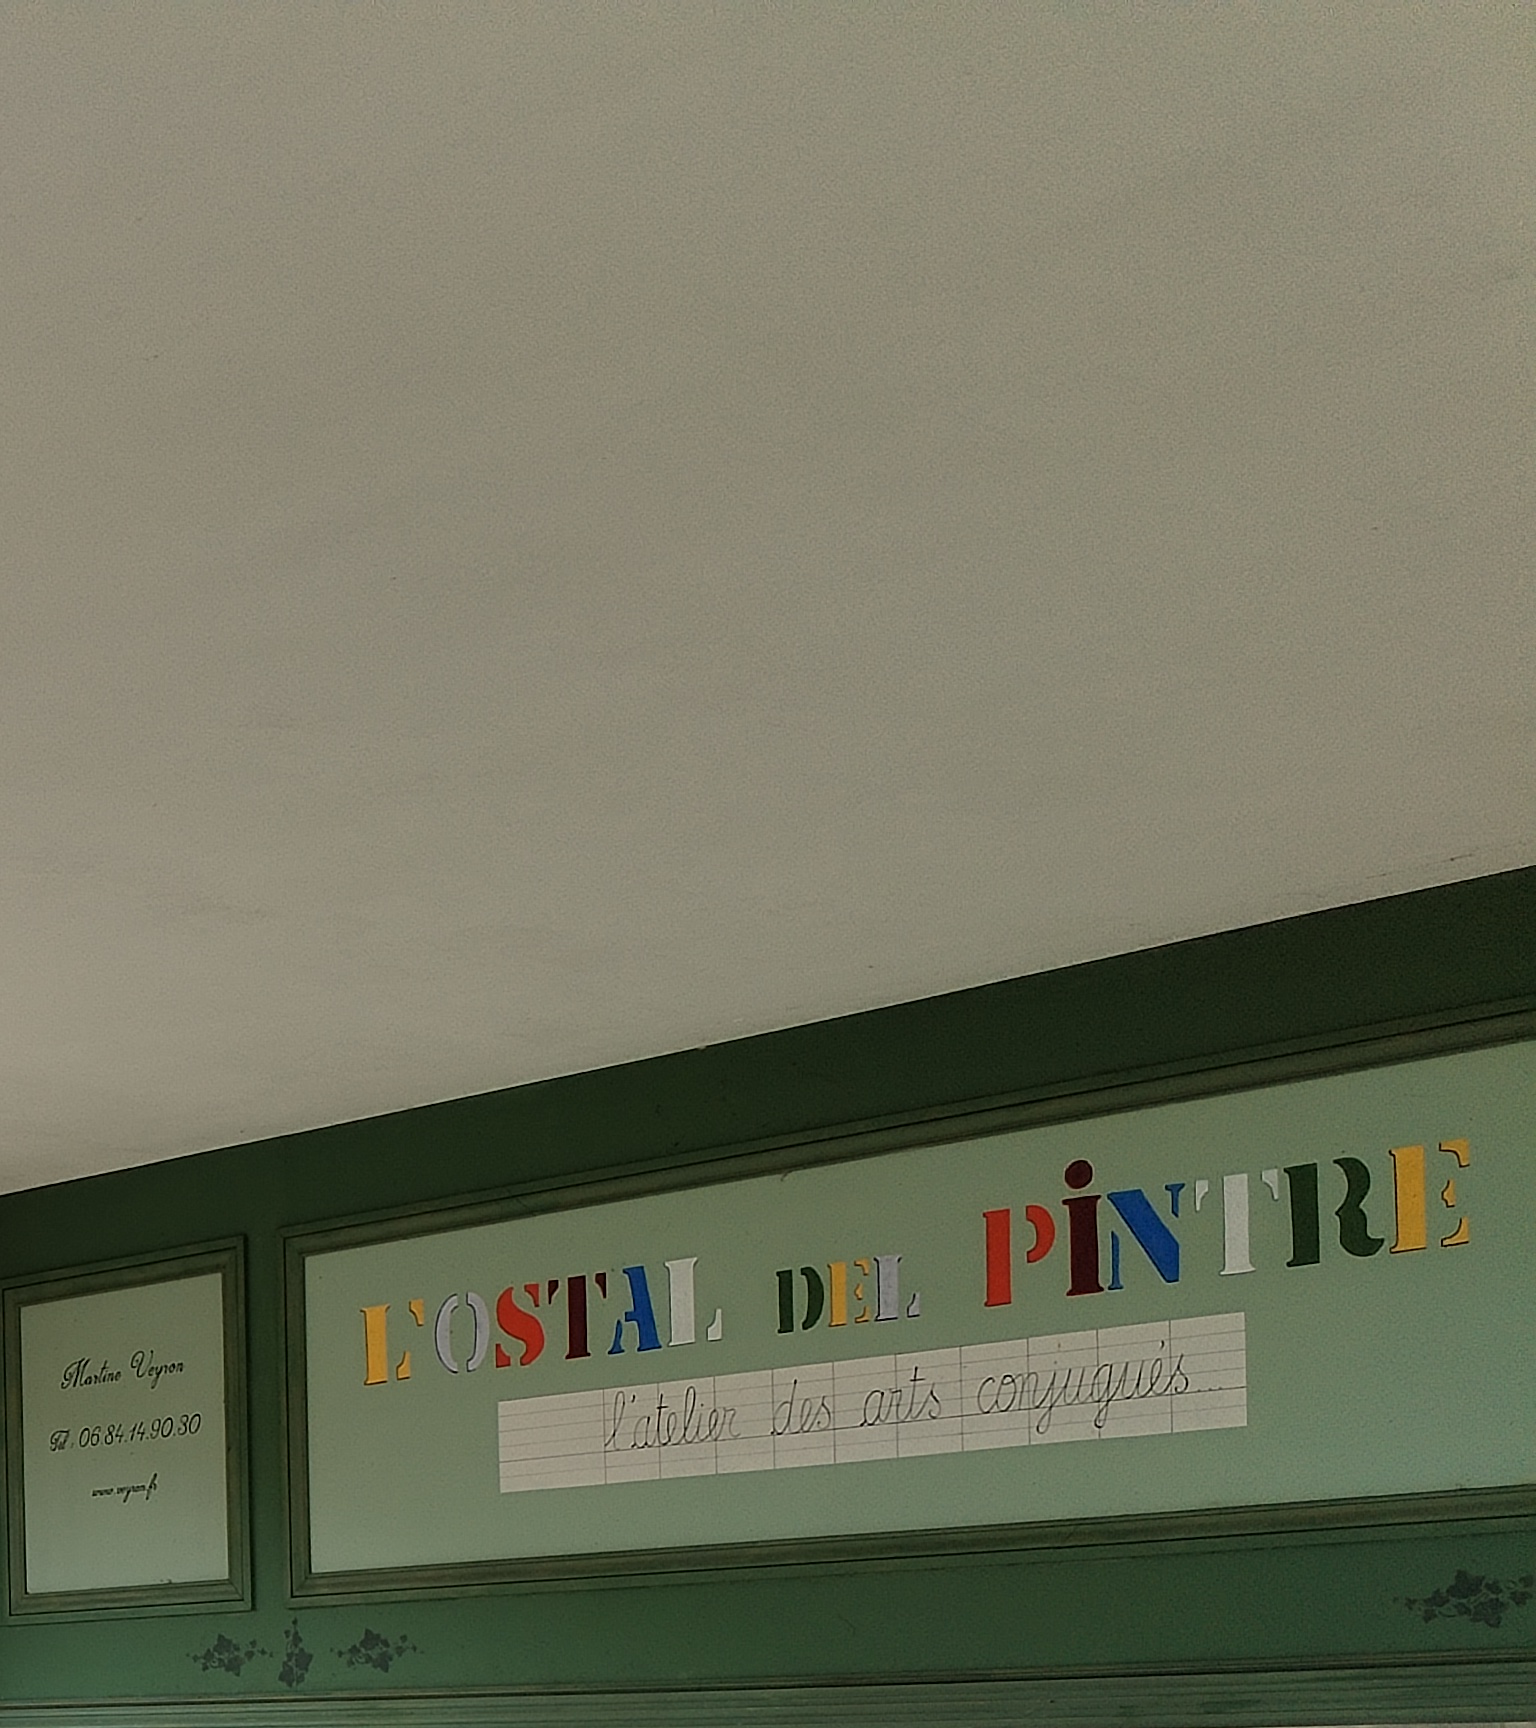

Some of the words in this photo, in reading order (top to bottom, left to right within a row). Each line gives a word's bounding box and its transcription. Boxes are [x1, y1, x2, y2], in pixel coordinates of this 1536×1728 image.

[360, 1257, 723, 1386] L'OSTAL
[775, 1255, 921, 1335] DEL
[60, 1357, 122, 1390] Martine
[130, 1349, 184, 1390] Veyron
[79, 1413, 202, 1448] 06.84.14.90.30
[604, 1384, 741, 1452] l'atelier
[770, 1379, 832, 1435] des
[859, 1365, 942, 1427] arts
